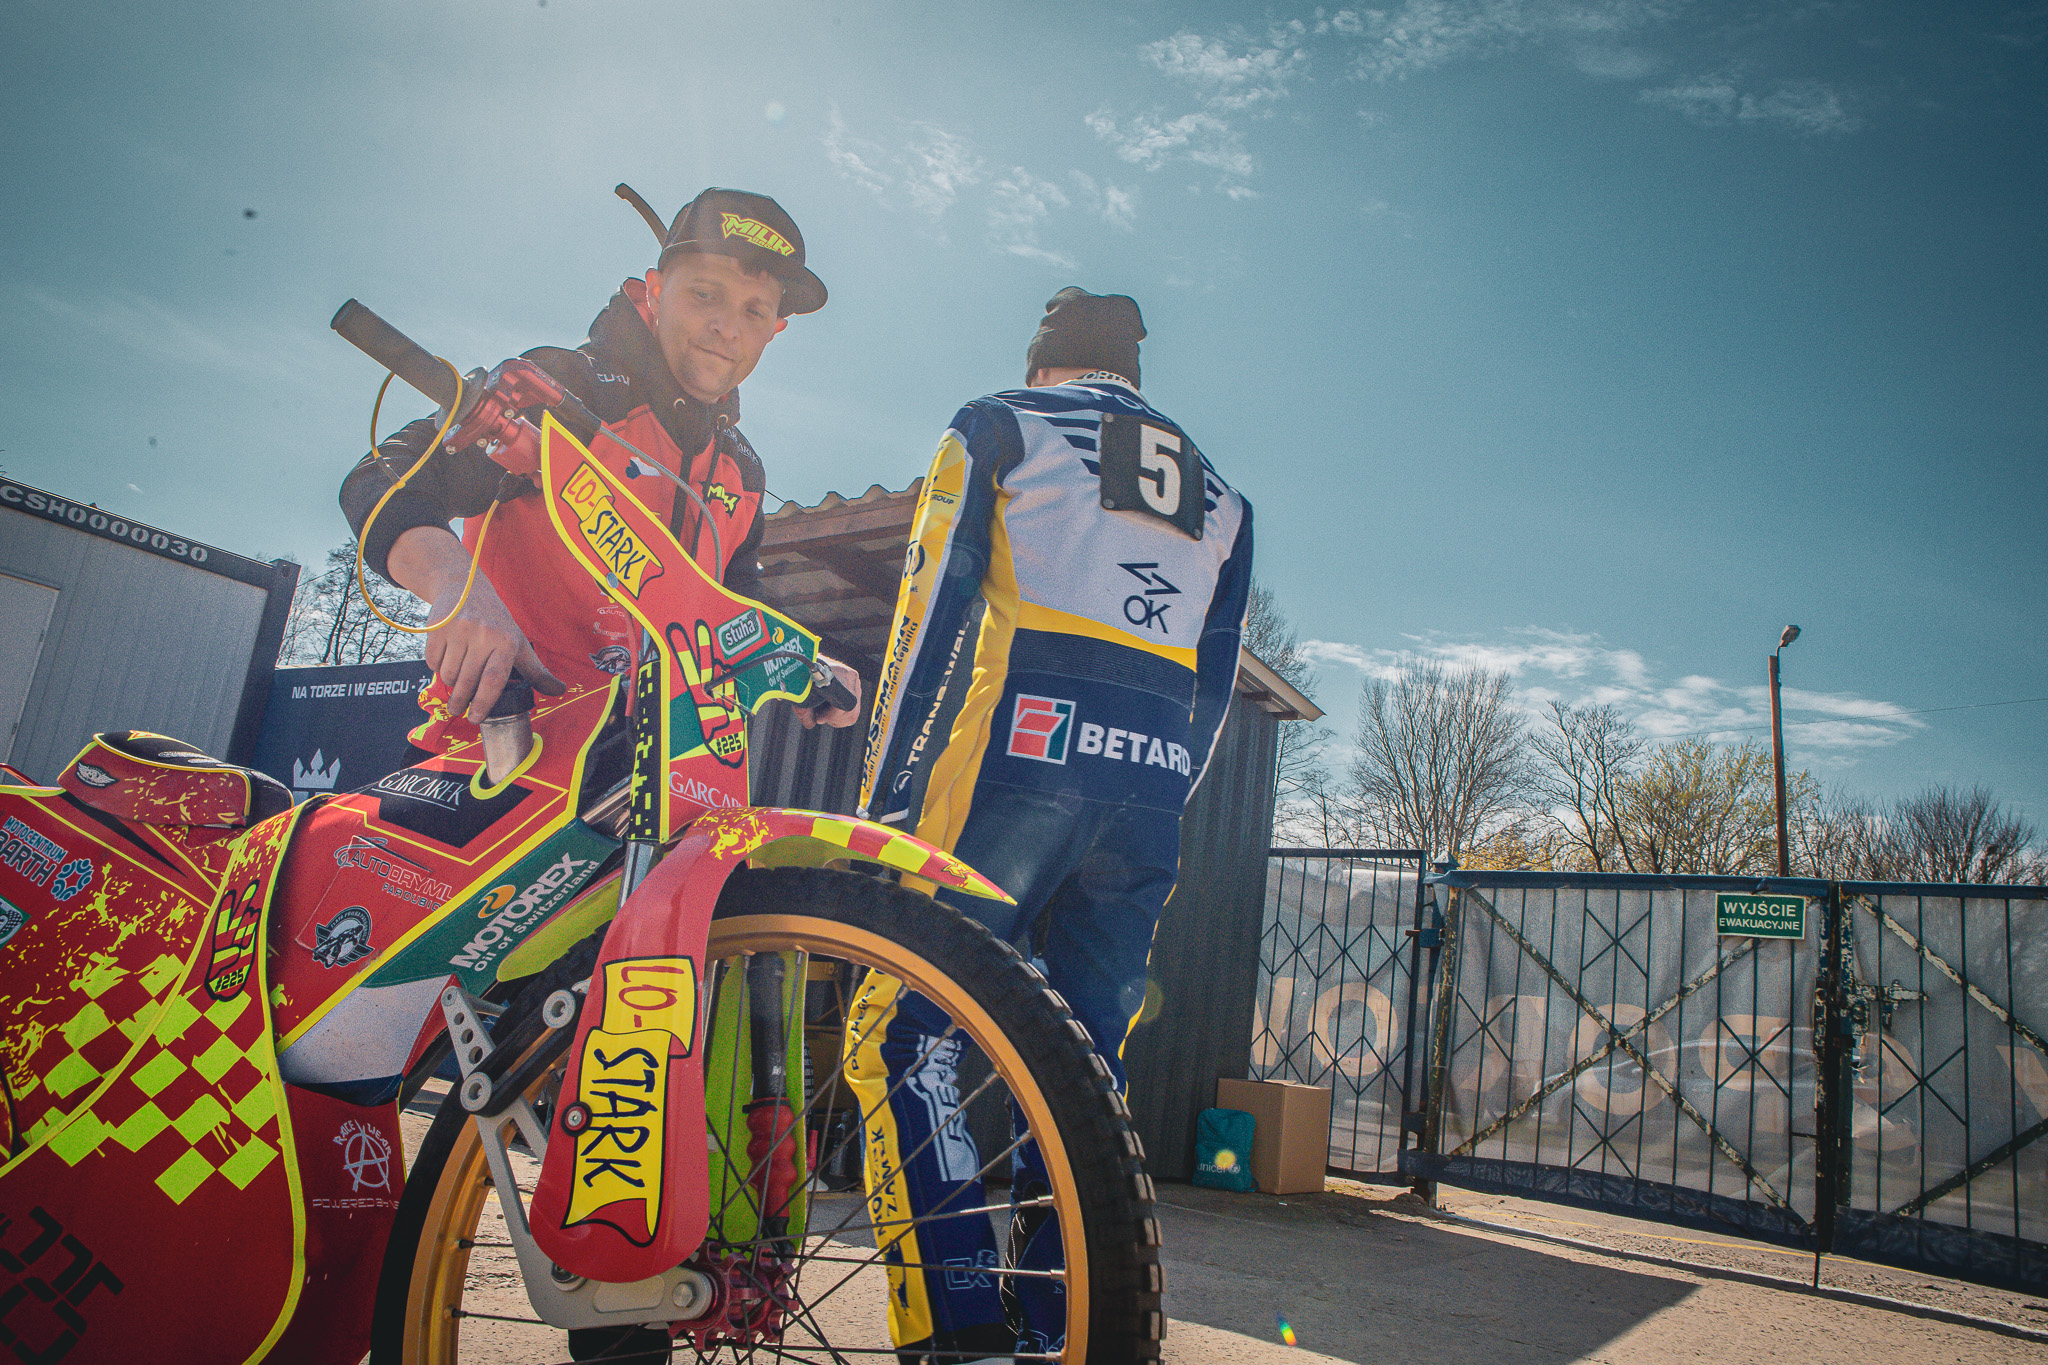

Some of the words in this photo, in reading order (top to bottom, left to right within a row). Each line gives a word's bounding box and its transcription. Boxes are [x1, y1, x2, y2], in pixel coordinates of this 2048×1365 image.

[725, 217, 790, 256] MILIK
[1138, 424, 1181, 516] 5
[587, 510, 646, 579] STARK
[725, 614, 756, 648] stuha
[1123, 595, 1171, 634] OK
[895, 621, 919, 666] Logistics
[292, 686, 307, 699] NA
[310, 683, 347, 698] TORZE
[348, 683, 352, 697] I
[354, 682, 367, 697] W
[367, 680, 410, 696] SERCU
[418, 676, 431, 692] Ż
[1077, 722, 1191, 777] BETARD
[378, 772, 469, 806] GARCAREK
[3, 816, 69, 864] MOTOCENTRUM
[449, 852, 588, 969] MOTOREX
[474, 950, 496, 972] Oil
[498, 935, 514, 950] of
[514, 860, 600, 935] Switzerland
[1719, 917, 1800, 931] EWAKUACYJNE
[1723, 900, 1797, 917] WYJŚCIE
[580, 1047, 660, 1189] STARK
